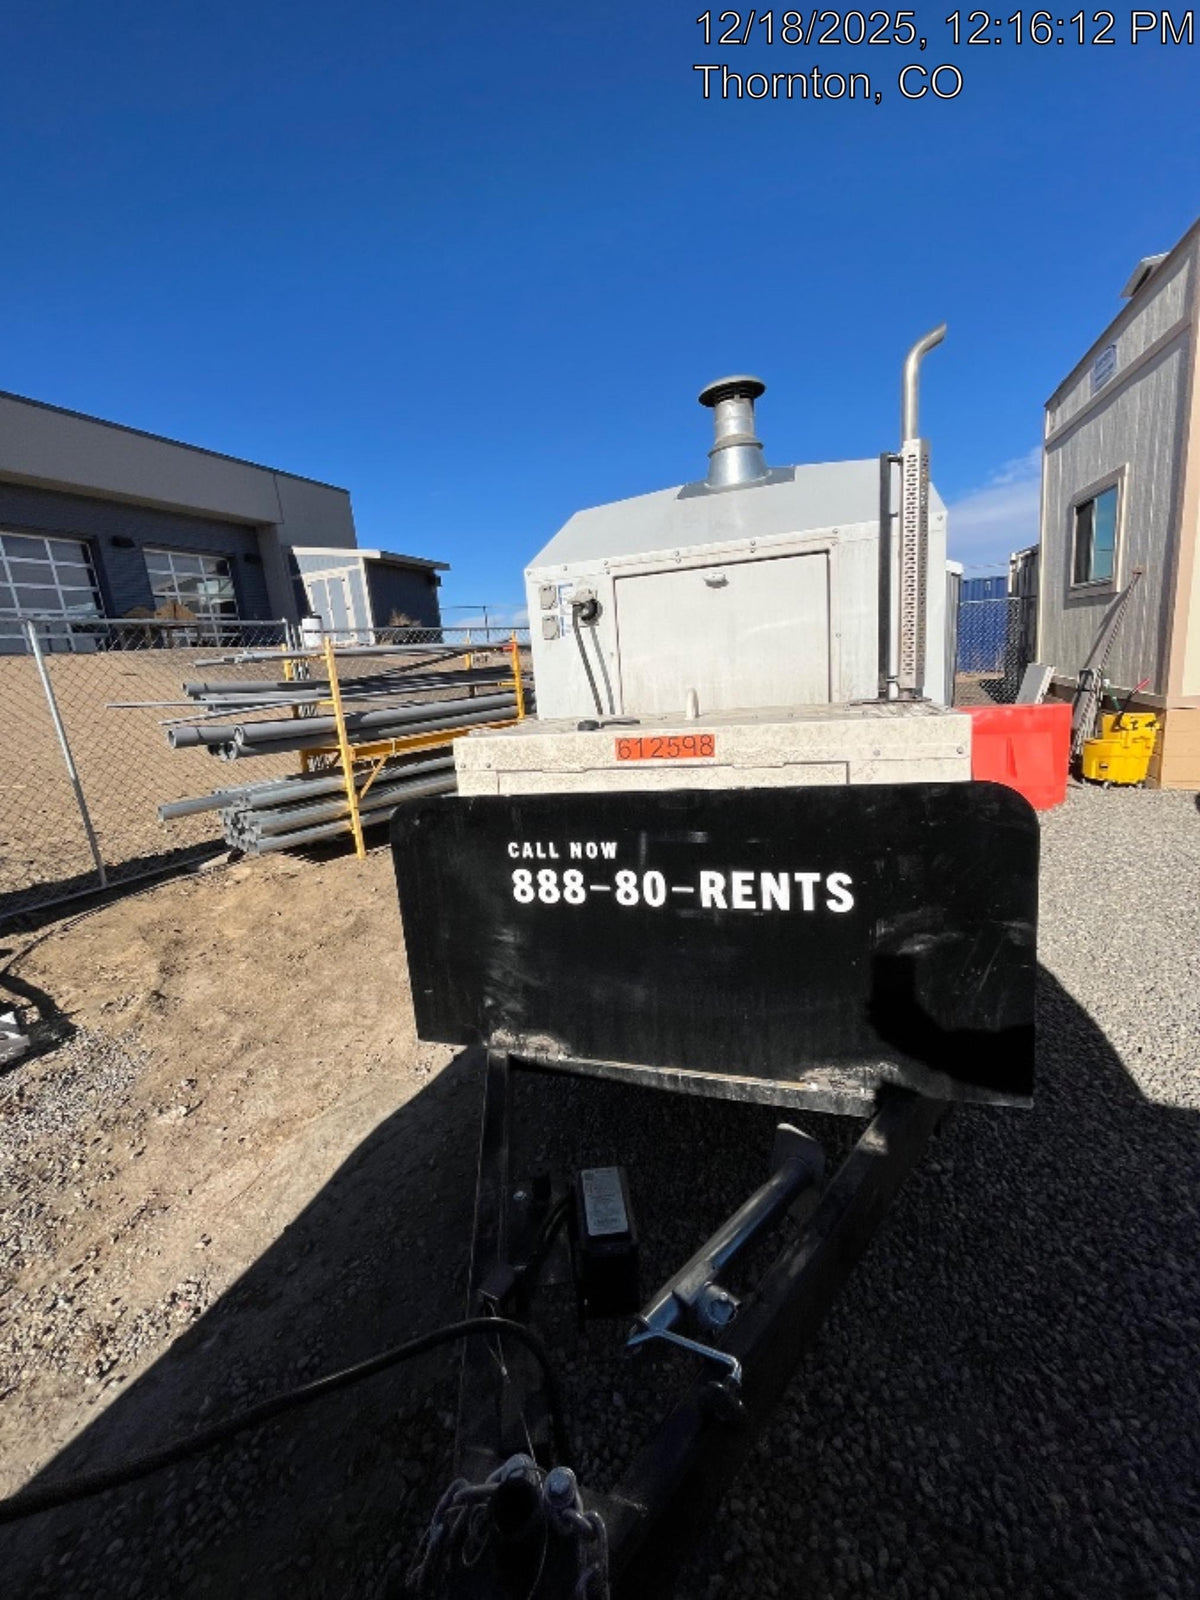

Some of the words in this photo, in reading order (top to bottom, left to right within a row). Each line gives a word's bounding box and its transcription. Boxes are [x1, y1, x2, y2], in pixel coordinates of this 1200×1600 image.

[617, 734, 714, 759] 612598
[508, 842, 559, 859] CALL
[570, 841, 618, 859] NOW
[512, 869, 855, 912] 888-80-RENTS
